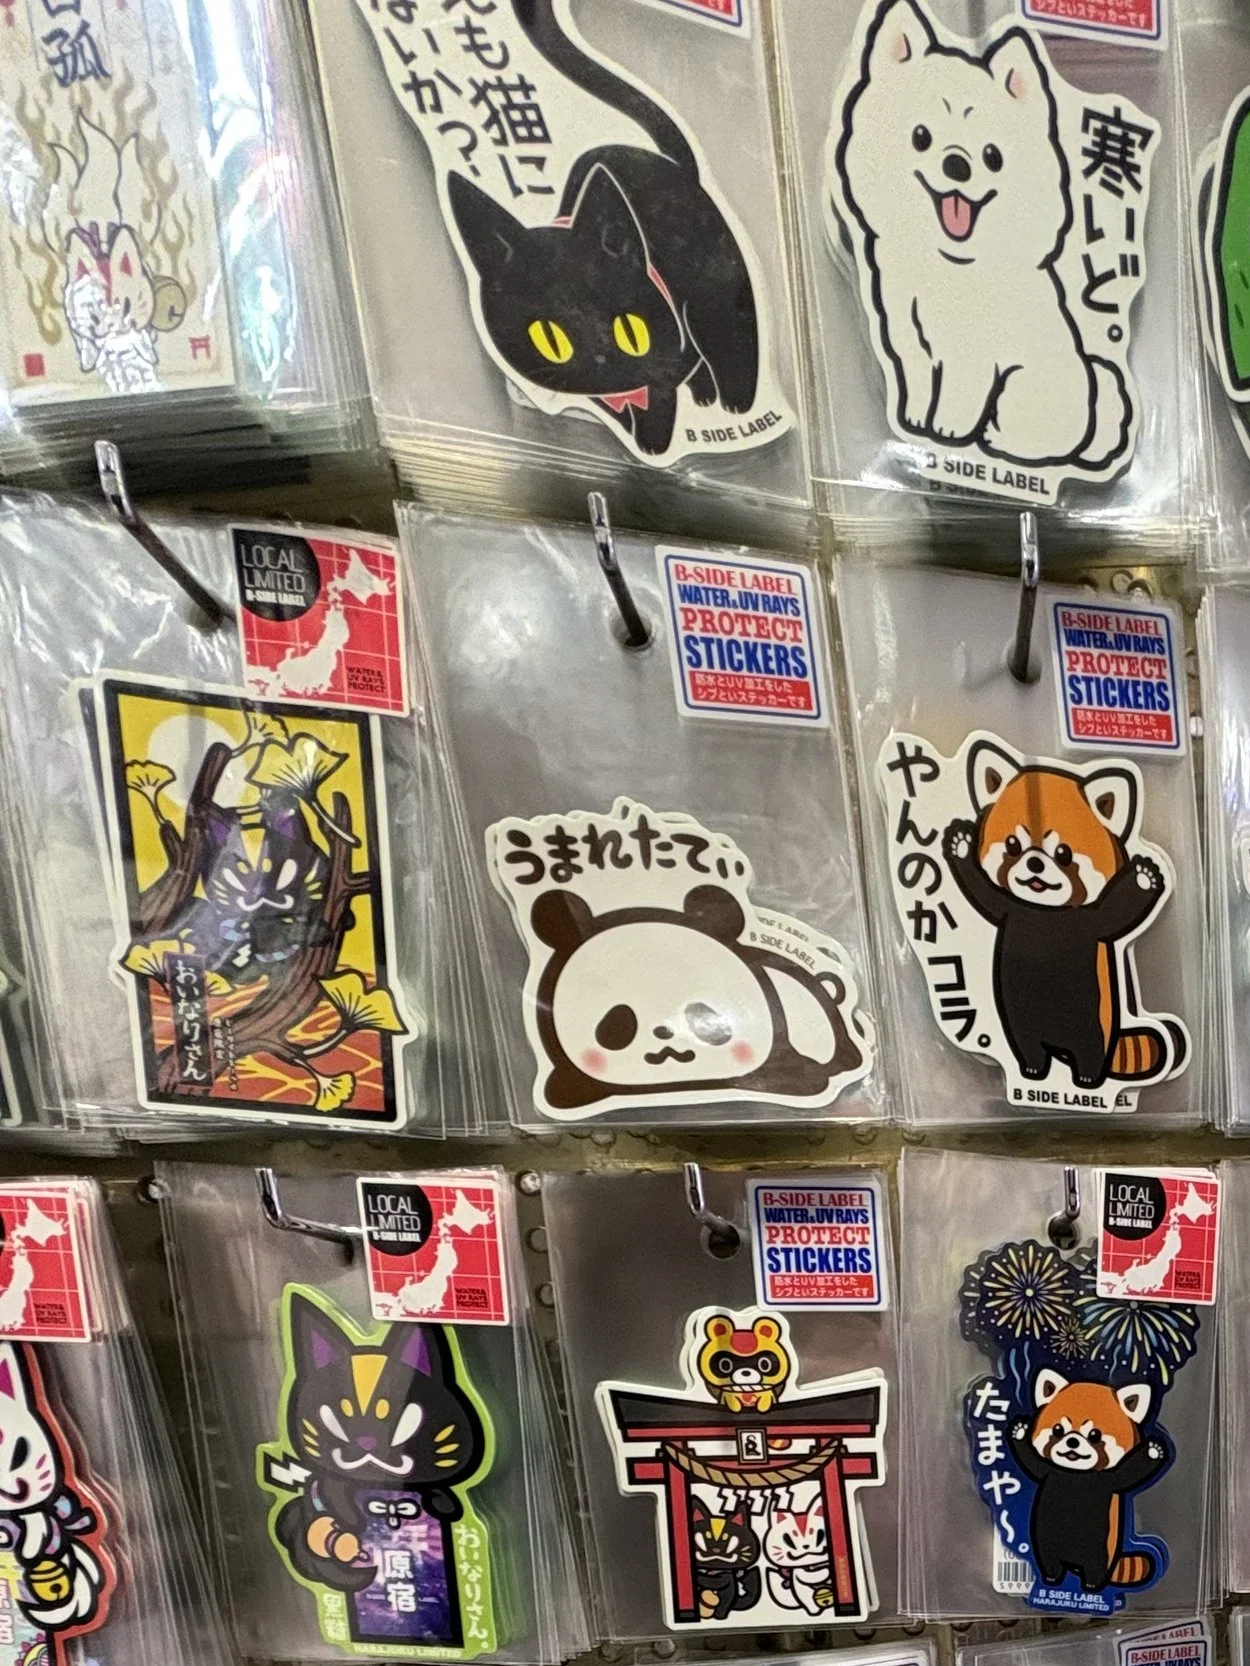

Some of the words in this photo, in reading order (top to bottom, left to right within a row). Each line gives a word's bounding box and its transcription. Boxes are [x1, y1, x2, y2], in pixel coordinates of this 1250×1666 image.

[1080, 106, 1155, 344] 寒いど。
[701, 423, 737, 444] SIDE
[738, 409, 783, 443] LABEL
[944, 458, 986, 484] SIDE
[993, 467, 1050, 496] LABEL
[242, 544, 303, 574] LOCAL
[243, 566, 307, 595] LIMITED
[674, 564, 737, 588] B-SIDE
[741, 572, 797, 595] LABEL
[680, 607, 803, 643] PROTECT
[684, 635, 808, 679] STICKERS
[1066, 652, 1167, 677] PROTECT
[1069, 676, 1170, 711] STICKERS
[176, 960, 207, 1081] おいなりさん
[1027, 1090, 1058, 1105] SIDE
[1063, 1093, 1108, 1109] LABEL
[367, 1194, 416, 1215] LOCAL
[1109, 1184, 1150, 1202] LOCAL
[1109, 1200, 1156, 1220] LIMITED
[766, 1226, 869, 1246] PROTECT
[767, 1247, 872, 1274] STICKERS
[384, 1550, 416, 1612] 原宿
